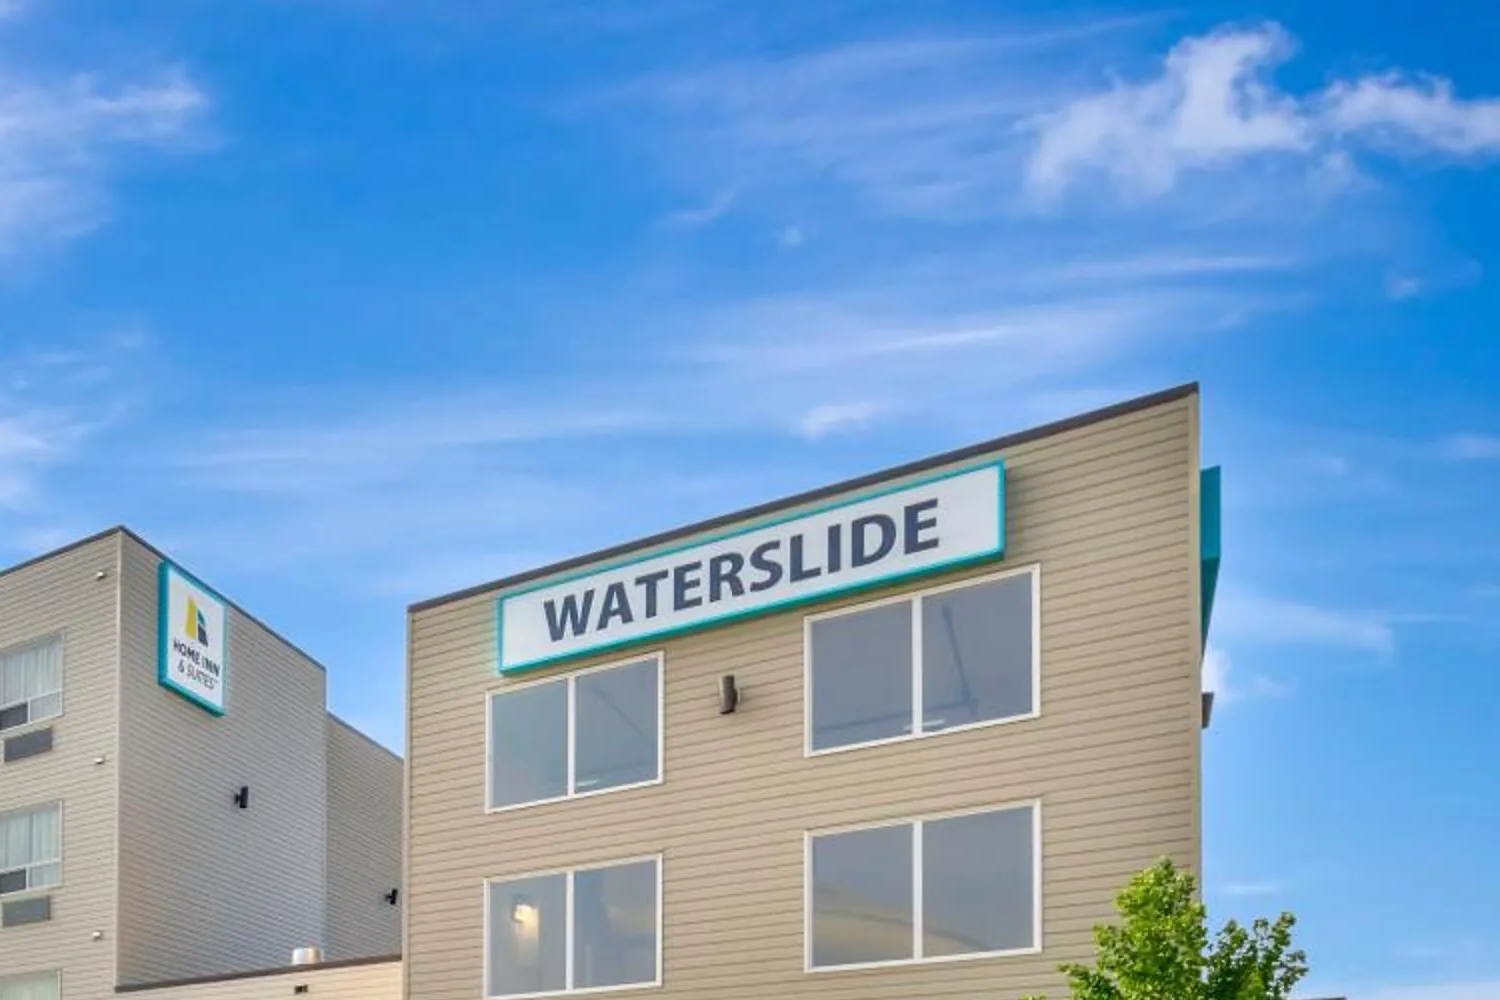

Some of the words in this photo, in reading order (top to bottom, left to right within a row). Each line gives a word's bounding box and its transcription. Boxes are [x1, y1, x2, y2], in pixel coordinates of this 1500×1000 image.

[543, 499, 939, 642] WATERSLIDE
[173, 637, 200, 665] HOME
[202, 656, 219, 677] INN
[177, 659, 184, 673] &
